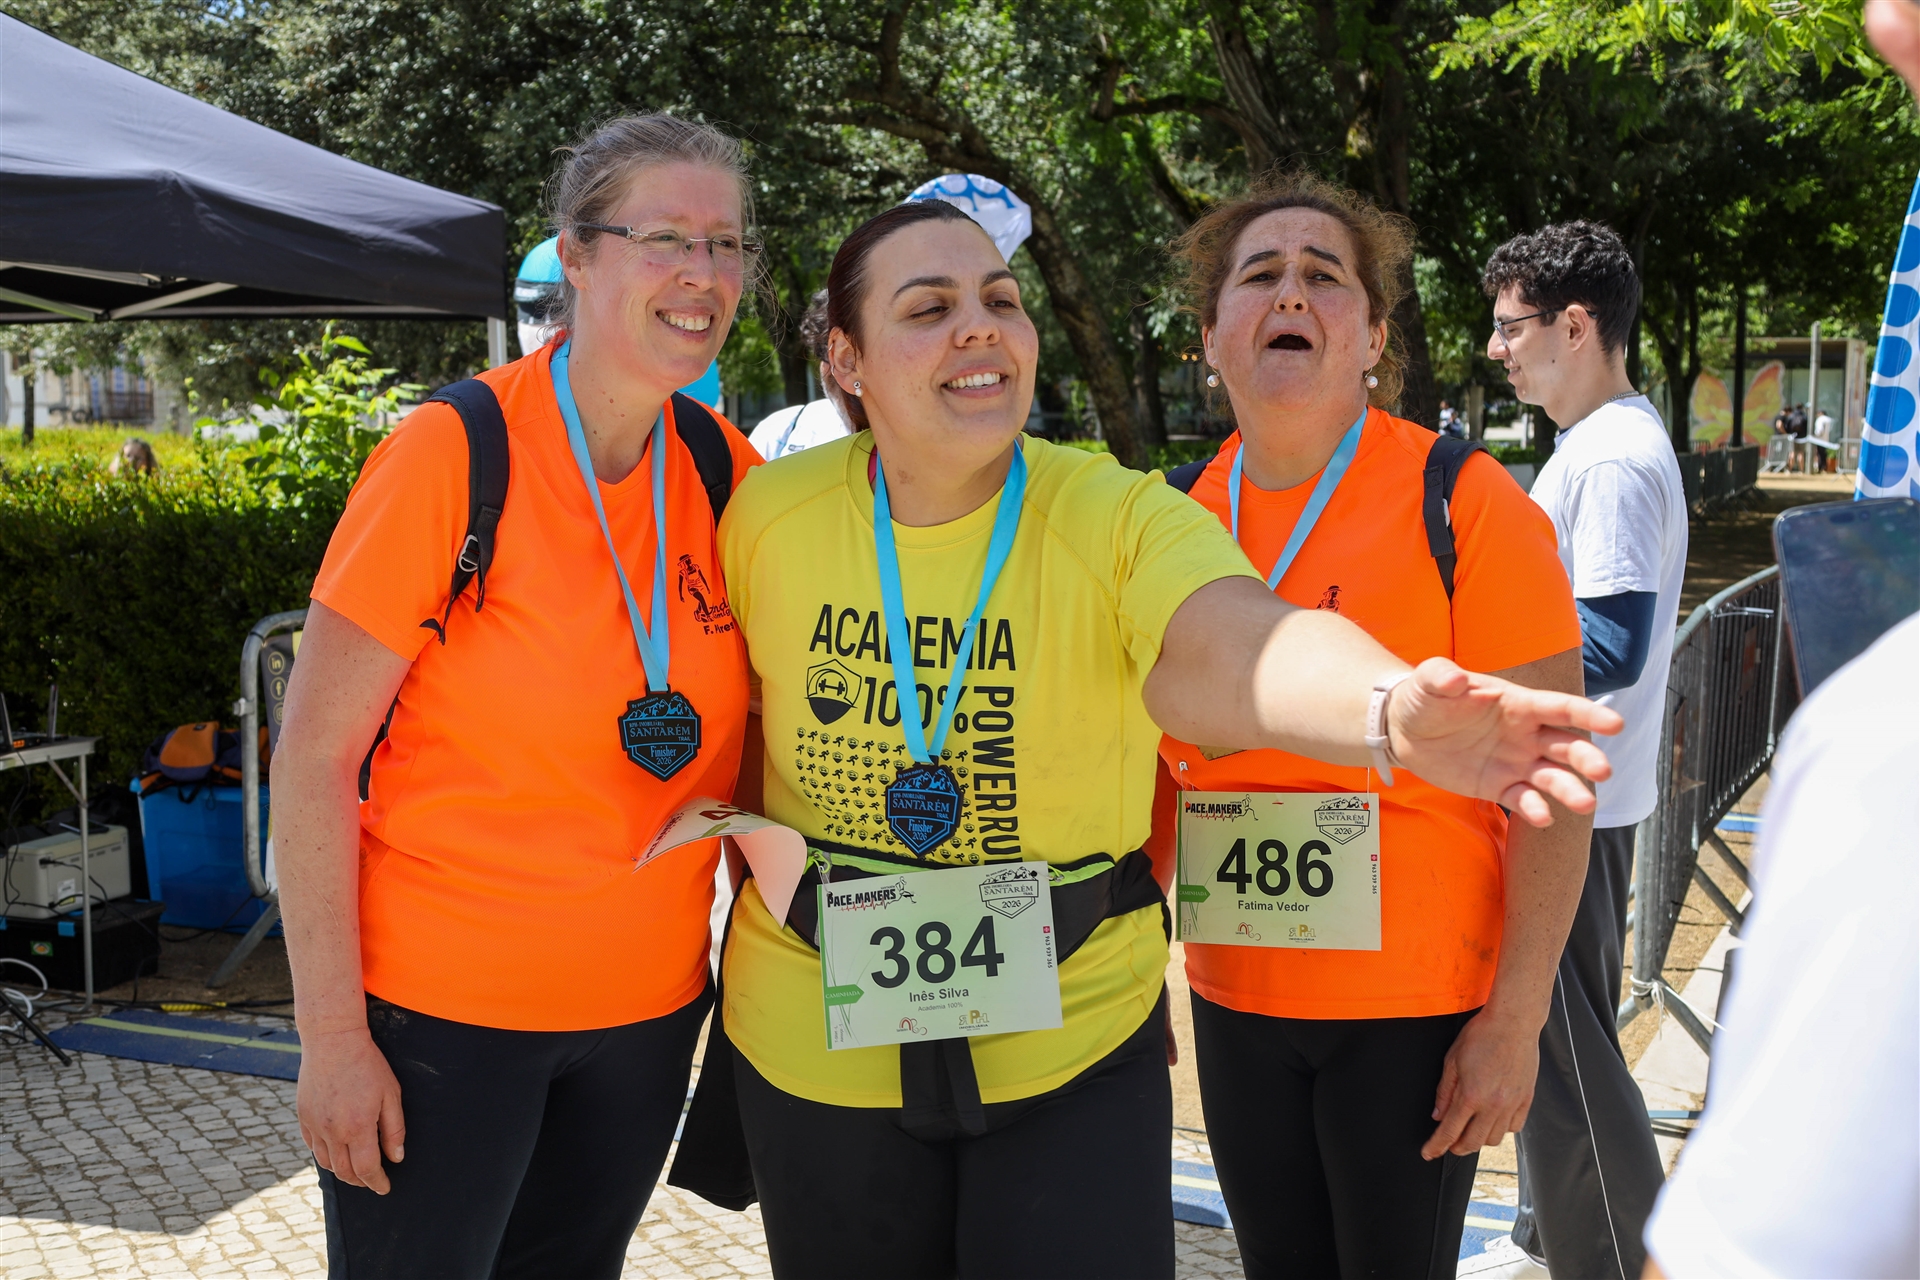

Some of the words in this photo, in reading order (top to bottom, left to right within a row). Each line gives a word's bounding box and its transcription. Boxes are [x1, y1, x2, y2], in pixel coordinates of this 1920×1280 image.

[703, 625, 714, 635] F.
[630, 724, 690, 738] SANTARÉM
[650, 745, 677, 757] Finisher
[656, 757, 672, 765] 2026
[972, 686, 1023, 865] POWERRU
[893, 799, 950, 813] SANTARÉM
[908, 819, 933, 833] Finisher
[912, 832, 927, 840] 2026
[1217, 838, 1334, 897] 486
[985, 885, 1033, 896] SANTARÉM
[827, 889, 896, 908] PACE.MAKERS
[1002, 900, 1021, 908] 2026
[1238, 900, 1274, 911] Fatima
[1277, 902, 1310, 912] Vedor
[870, 915, 1005, 989] 384
[826, 991, 860, 999] CAMINHADA
[909, 991, 935, 1003] Inês
[939, 987, 969, 1000] Silva
